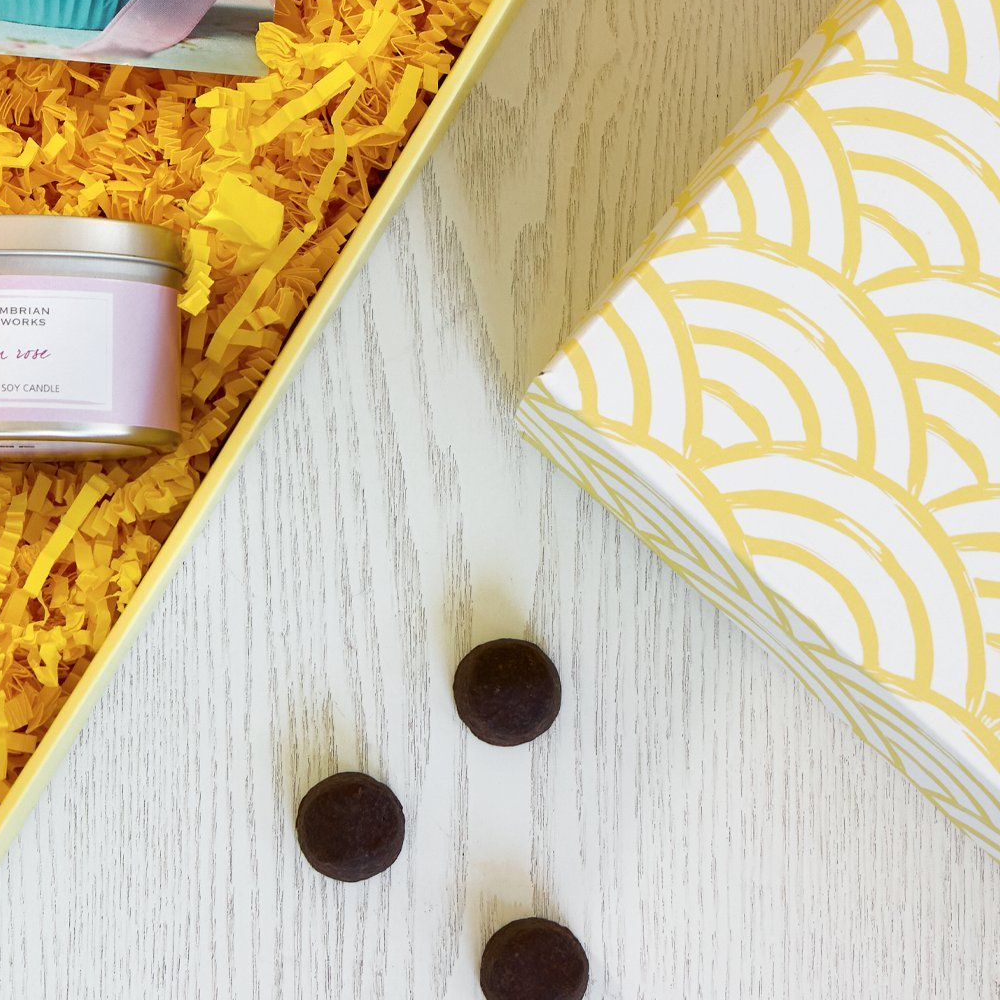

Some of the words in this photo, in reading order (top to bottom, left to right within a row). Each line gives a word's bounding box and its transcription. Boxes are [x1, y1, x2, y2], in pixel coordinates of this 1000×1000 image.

[16, 348, 52, 360] rose
[1, 383, 21, 393] SOY
[23, 383, 60, 393] CANDLE
